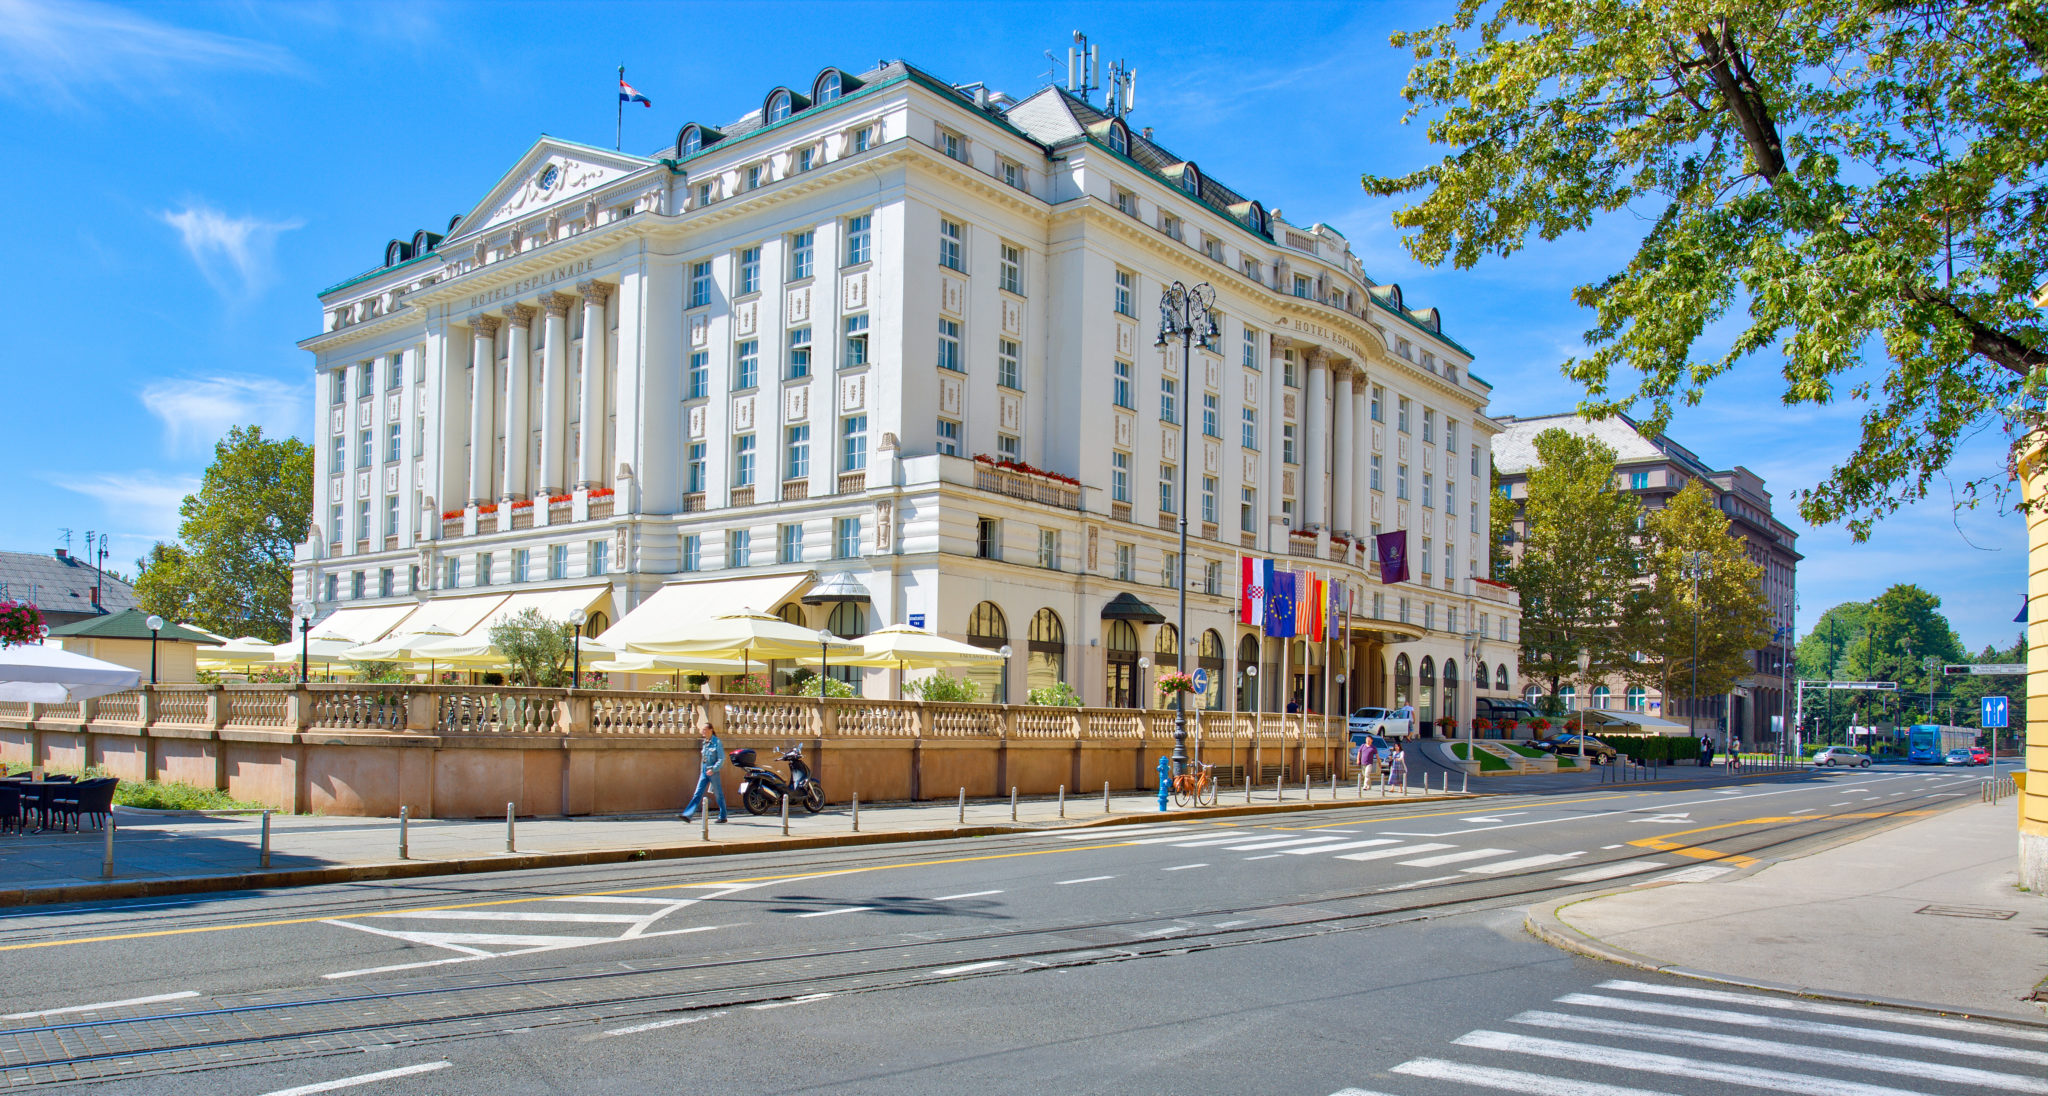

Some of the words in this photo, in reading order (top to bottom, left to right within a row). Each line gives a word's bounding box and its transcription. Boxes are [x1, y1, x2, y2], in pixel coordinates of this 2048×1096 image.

[471, 287, 509, 308] HOTEL
[515, 258, 593, 294] ESPLANADE
[1295, 320, 1329, 338] HOTEL
[1332, 332, 1367, 368] ESPLAN
